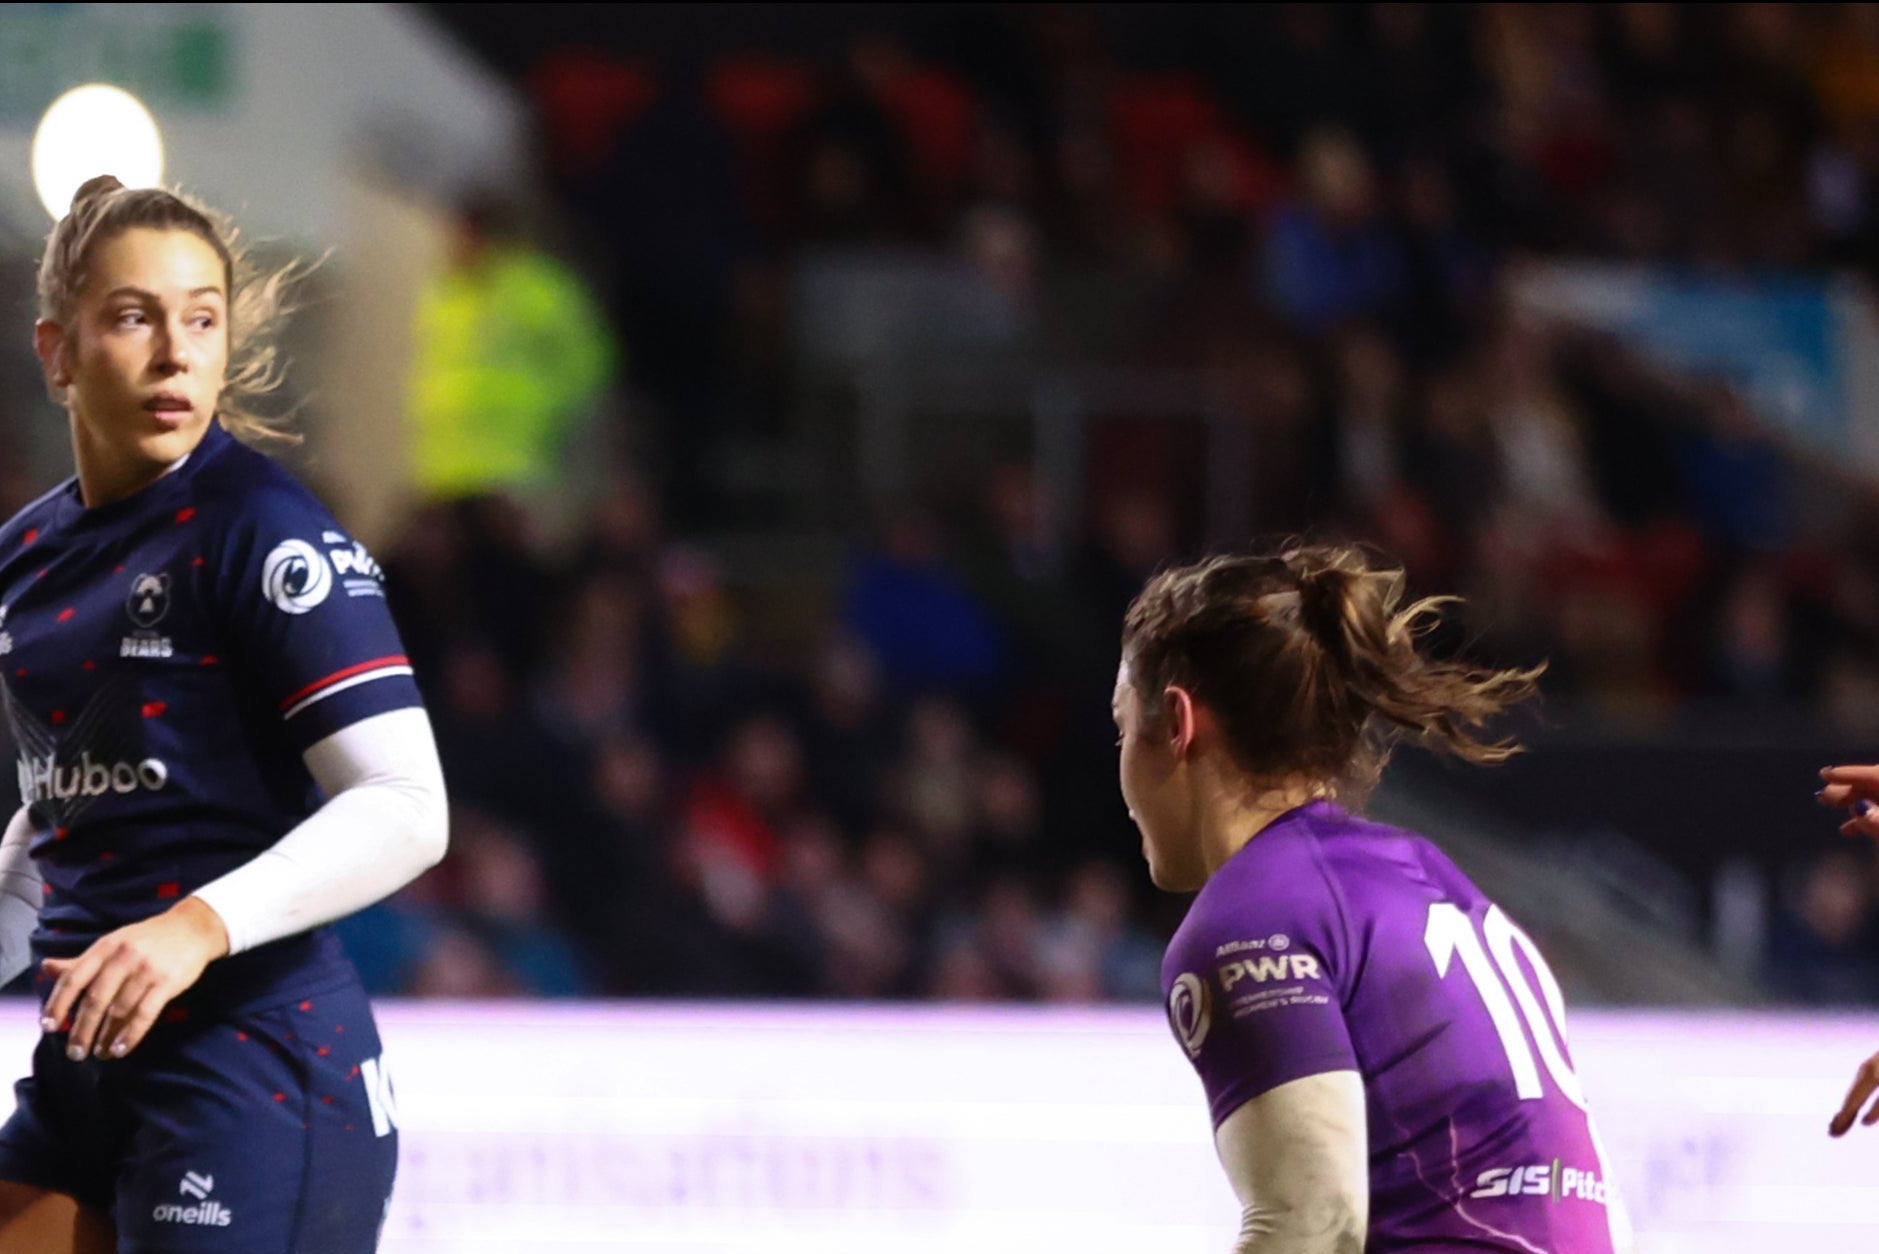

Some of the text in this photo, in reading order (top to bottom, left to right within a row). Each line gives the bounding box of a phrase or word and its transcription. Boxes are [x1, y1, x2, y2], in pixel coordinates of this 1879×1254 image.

[32, 751, 168, 801] Huboo
[1219, 954, 1321, 992] PWR
[1423, 902, 1588, 1115] 10
[1470, 1165, 1550, 1198] SIS
[153, 1201, 232, 1226] oneills
